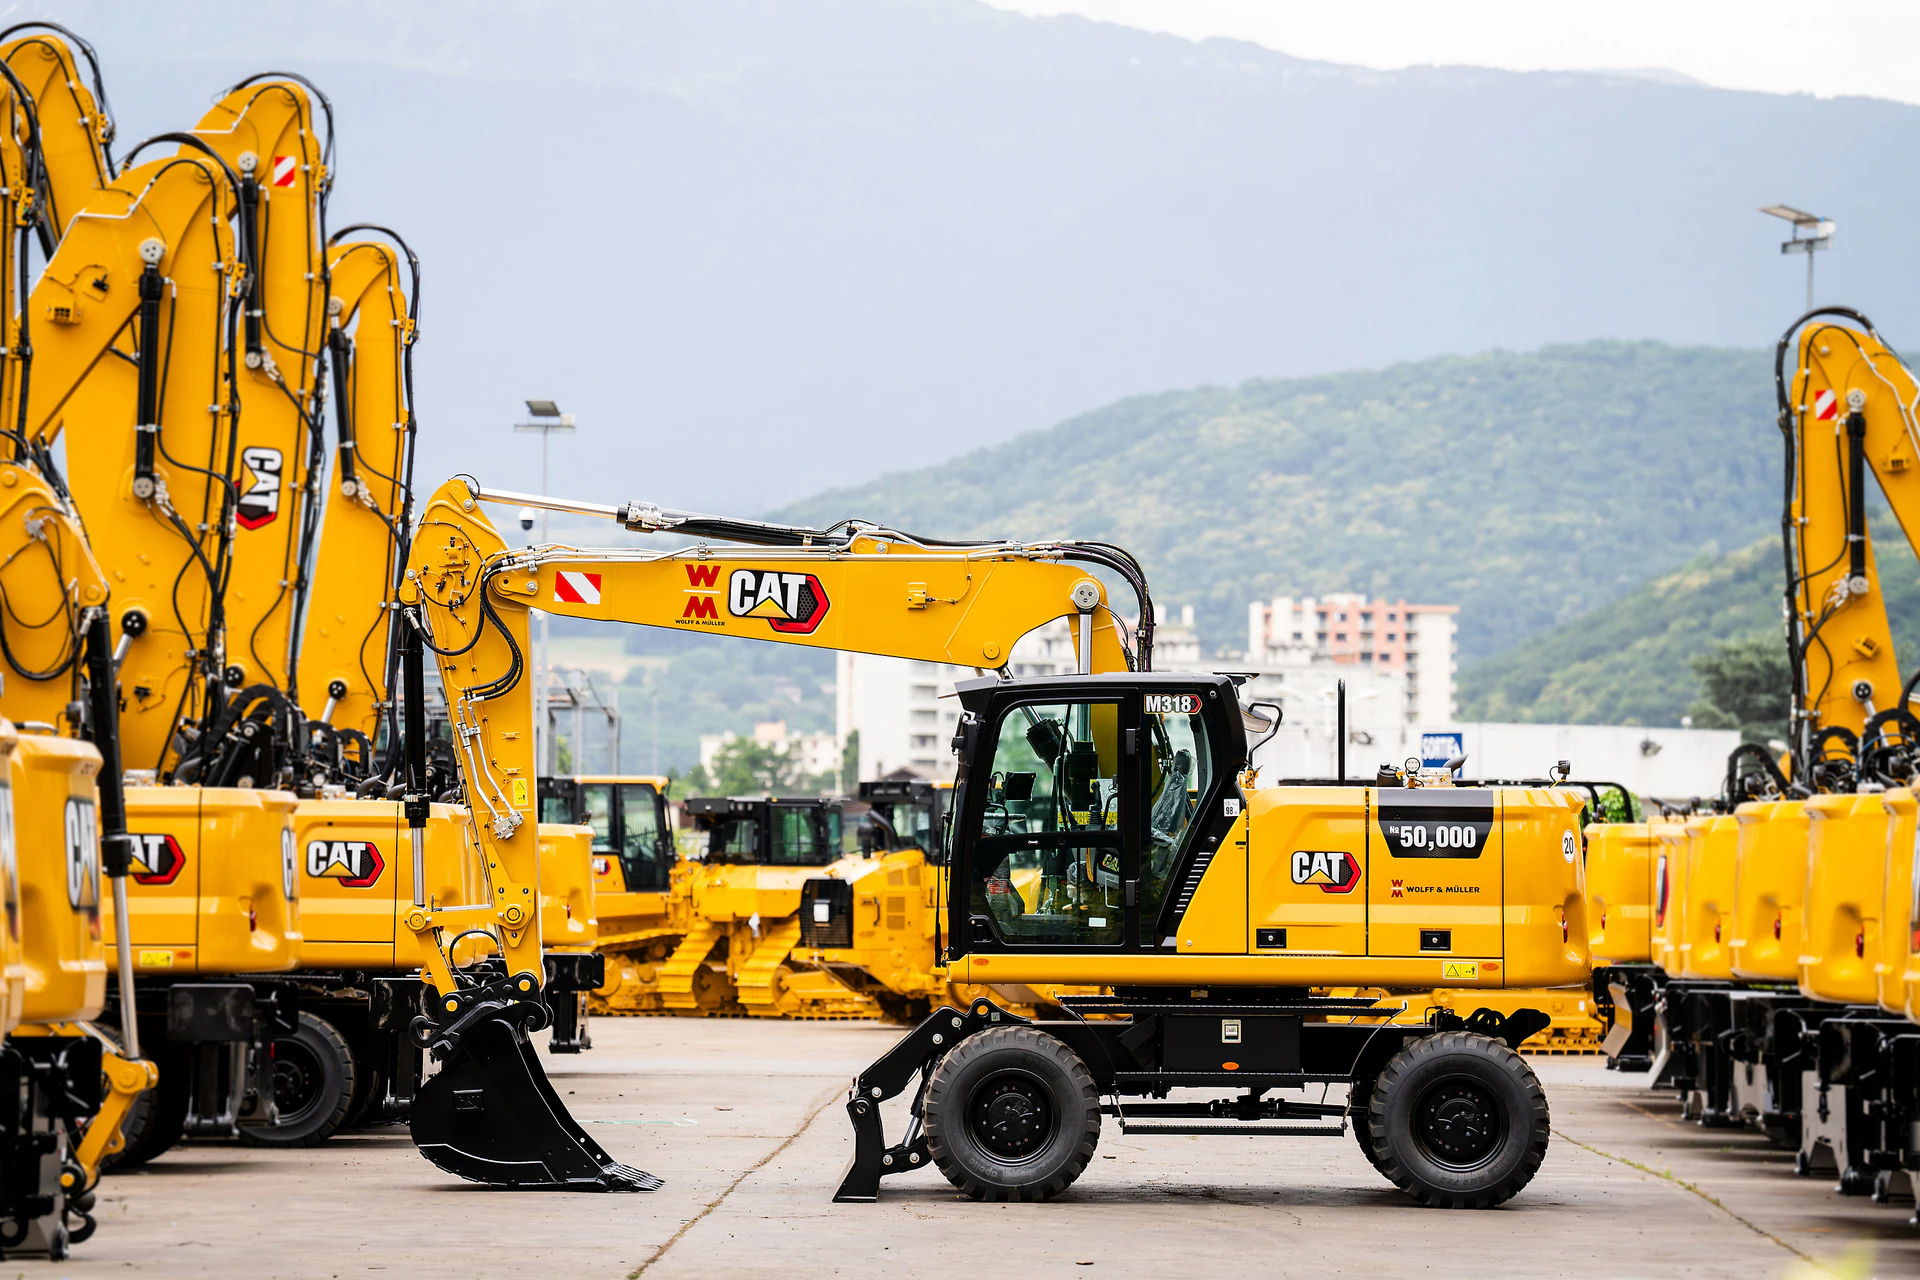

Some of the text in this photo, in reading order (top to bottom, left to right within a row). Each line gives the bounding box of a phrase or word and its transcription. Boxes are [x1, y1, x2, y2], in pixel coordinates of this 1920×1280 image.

[240, 447, 282, 513] CAT
[685, 564, 721, 587] W
[730, 569, 807, 619] CAT
[683, 596, 719, 619] M
[1146, 695, 1191, 713] M318
[1226, 806, 1234, 815] 98
[1400, 825, 1476, 851] 50,000
[1564, 837, 1574, 854] 20
[130, 834, 166, 874] AT
[308, 840, 367, 877] CAT
[1292, 852, 1344, 884] CAT
[1391, 879, 1403, 887] W
[1391, 890, 1403, 898] M
[1446, 884, 1480, 893] MÜLLER
[968, 1157, 999, 1180] apollo
